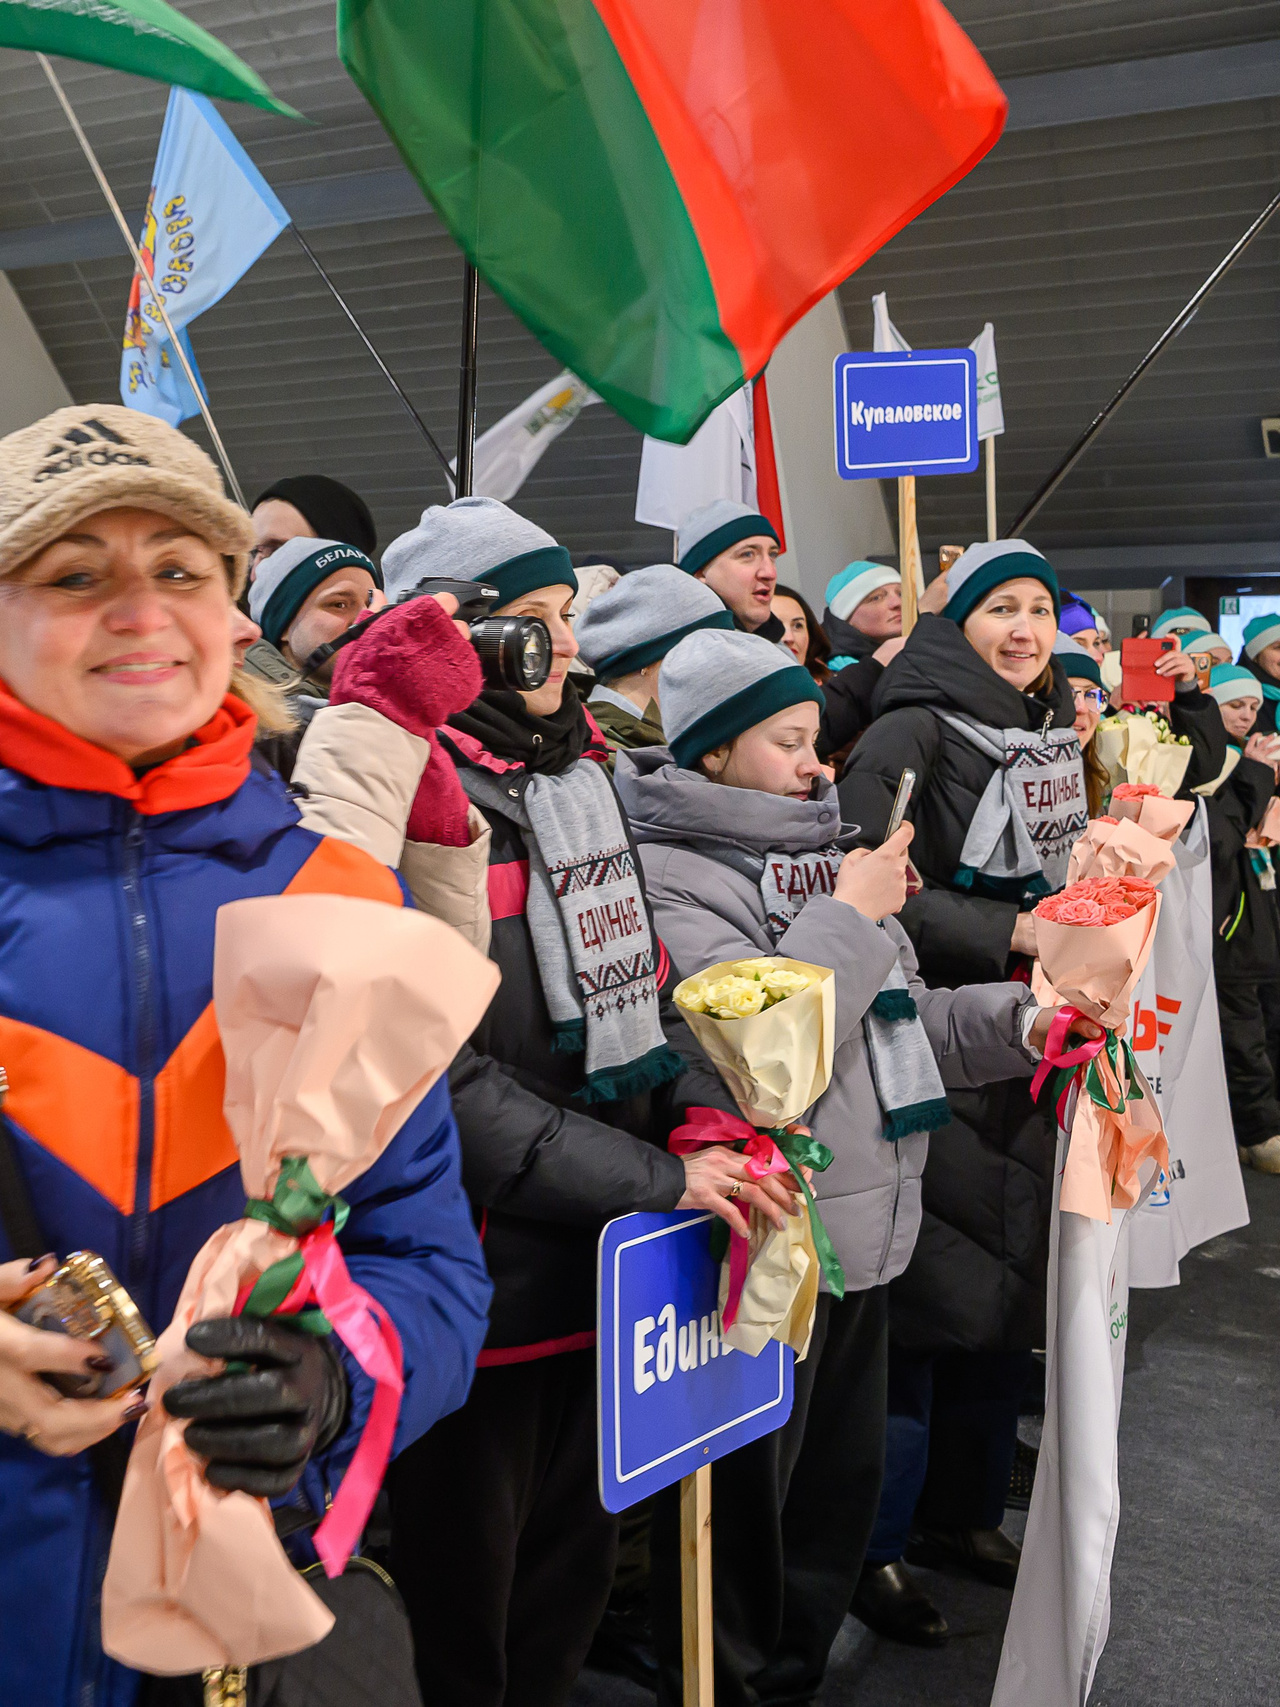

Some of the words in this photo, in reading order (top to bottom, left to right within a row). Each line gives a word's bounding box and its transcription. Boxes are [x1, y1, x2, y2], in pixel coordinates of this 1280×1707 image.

[851, 400, 962, 432] Купаловское
[33, 446, 150, 483] adidas
[771, 860, 839, 902] ЕДИН
[577, 896, 642, 954] ЕДИНЫЕ
[634, 1303, 735, 1395] Един
